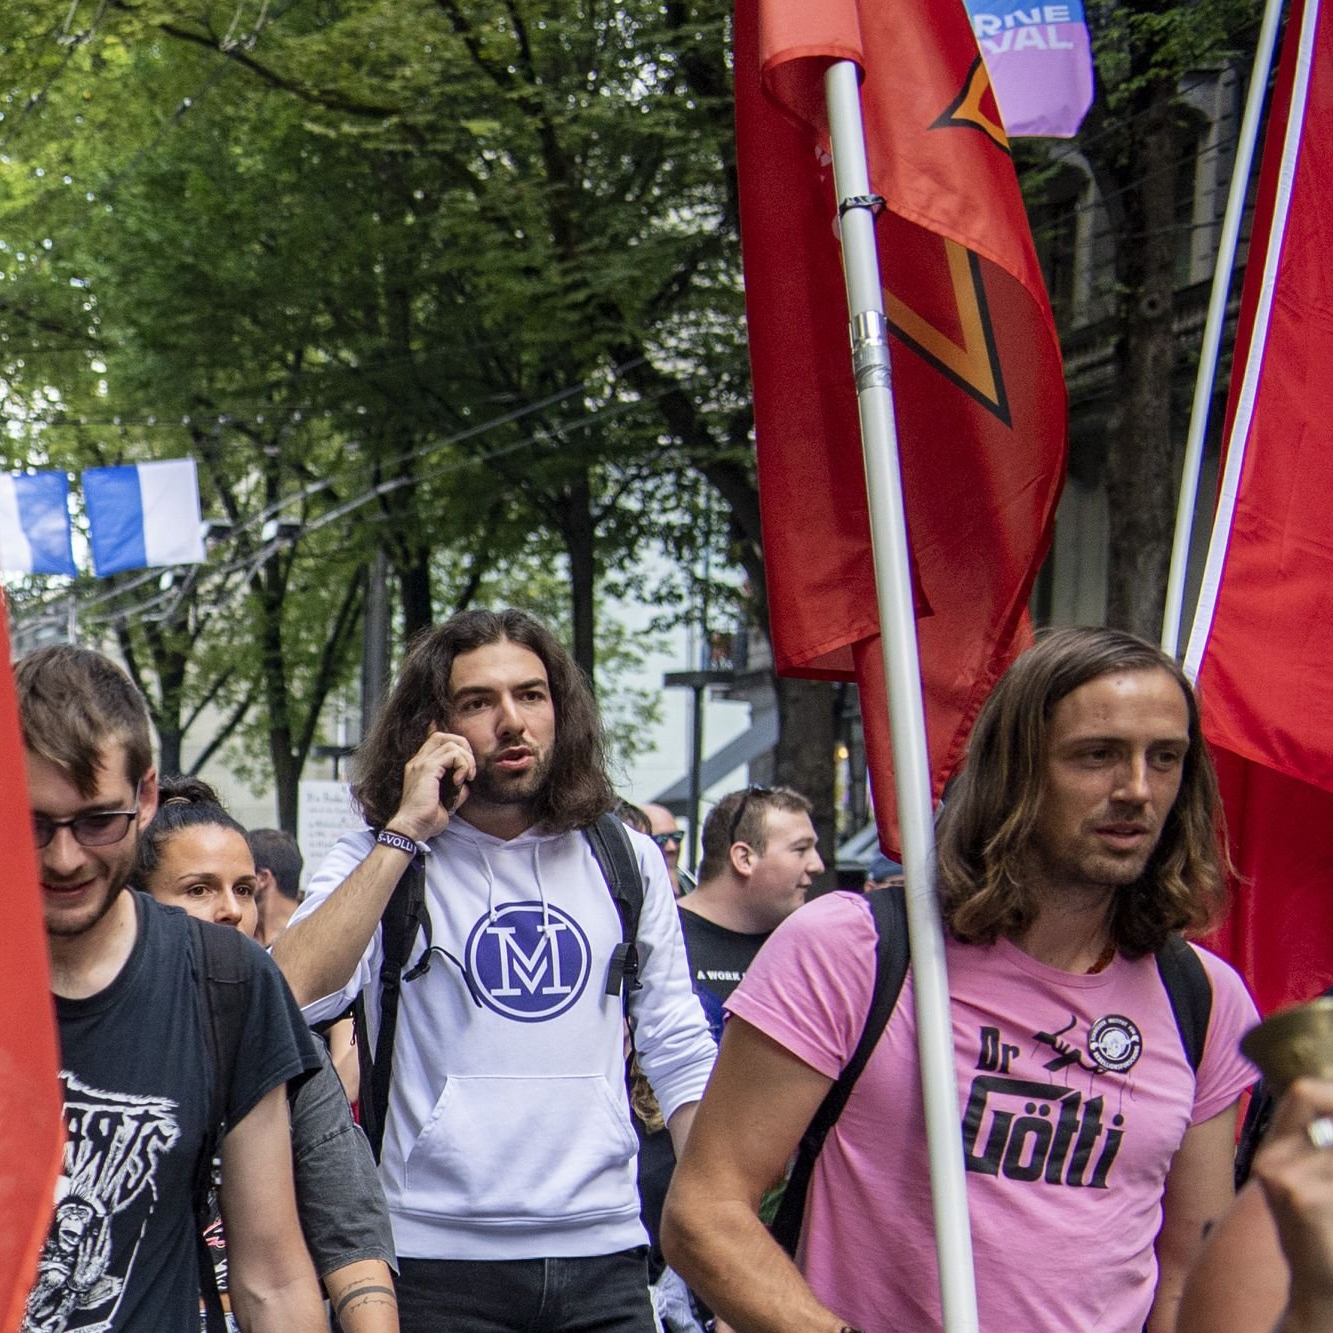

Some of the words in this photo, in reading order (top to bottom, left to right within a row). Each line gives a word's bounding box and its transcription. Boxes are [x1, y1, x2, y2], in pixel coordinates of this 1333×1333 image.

[706, 970, 742, 981] WORK
[974, 1026, 1020, 1074] Dr
[962, 1075, 1126, 1189] Götti
